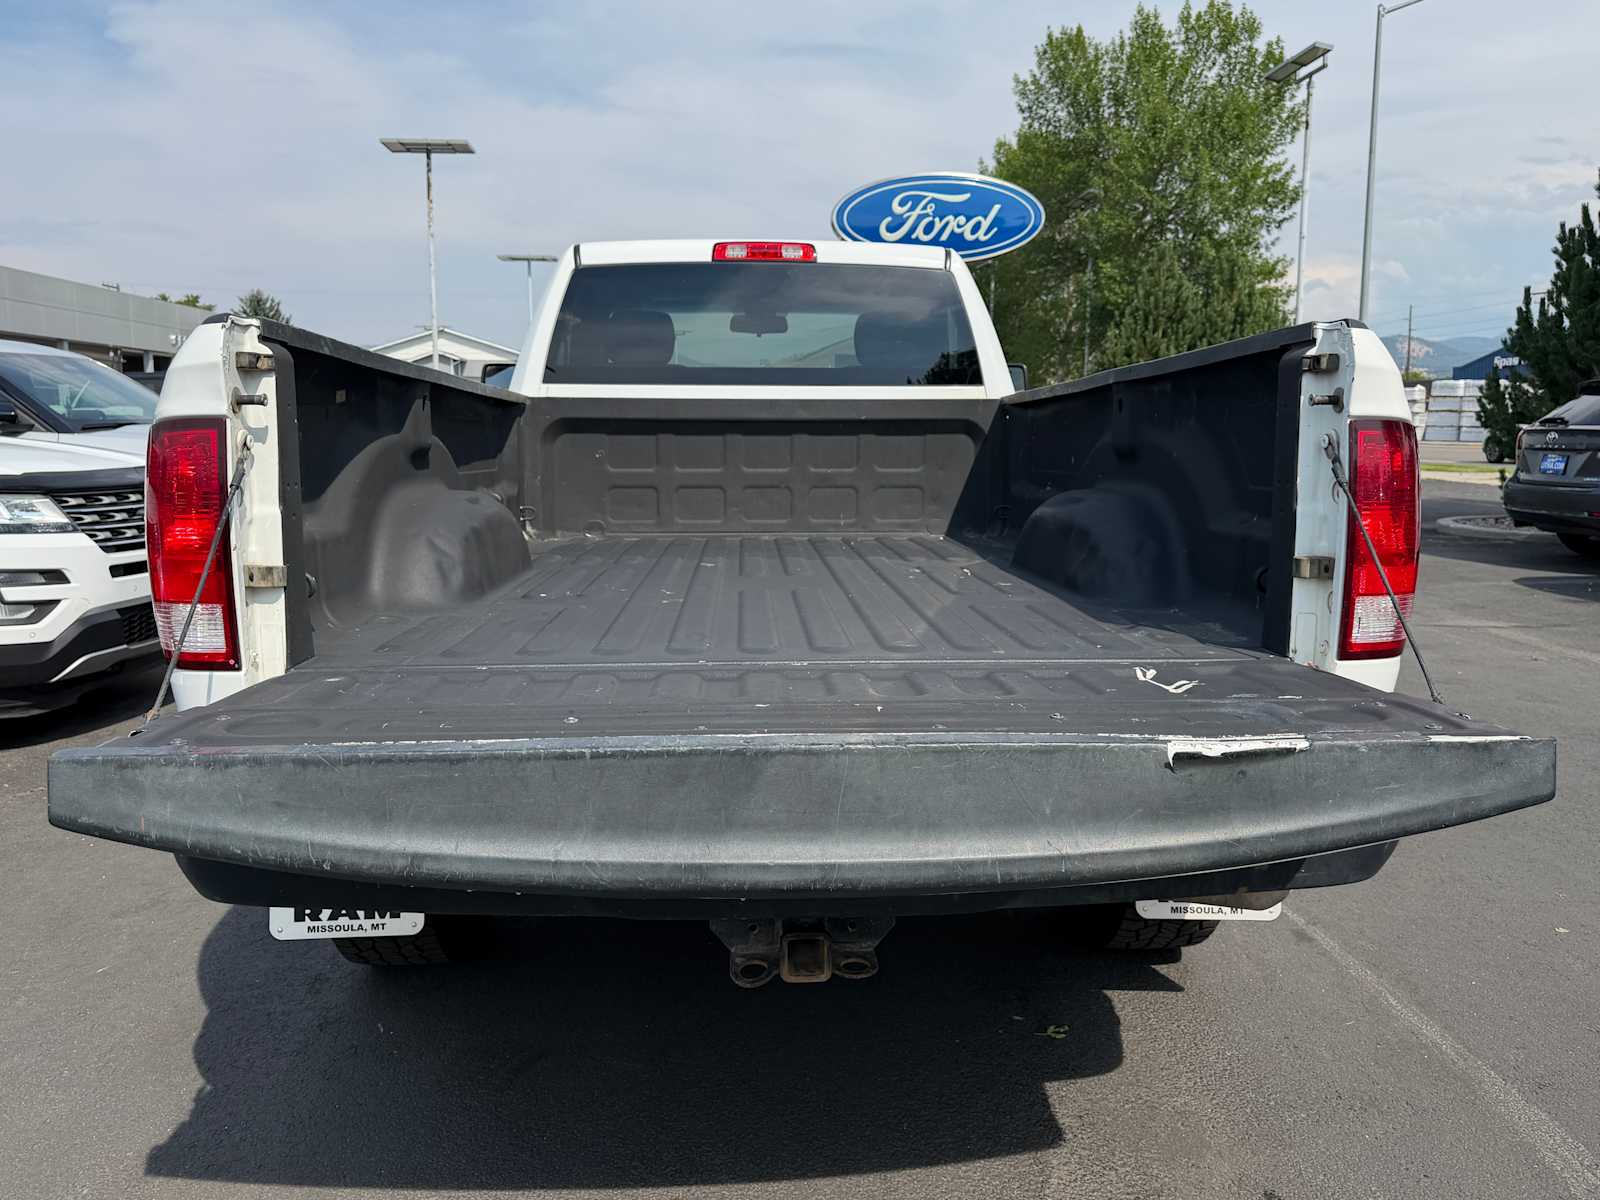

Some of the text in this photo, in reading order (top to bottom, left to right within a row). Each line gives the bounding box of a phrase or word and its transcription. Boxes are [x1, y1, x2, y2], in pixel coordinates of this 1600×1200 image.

[879, 190, 1002, 242] Ford
[1170, 906, 1227, 915] MISSOULA,
[307, 922, 388, 934] MISSOULA, MT
